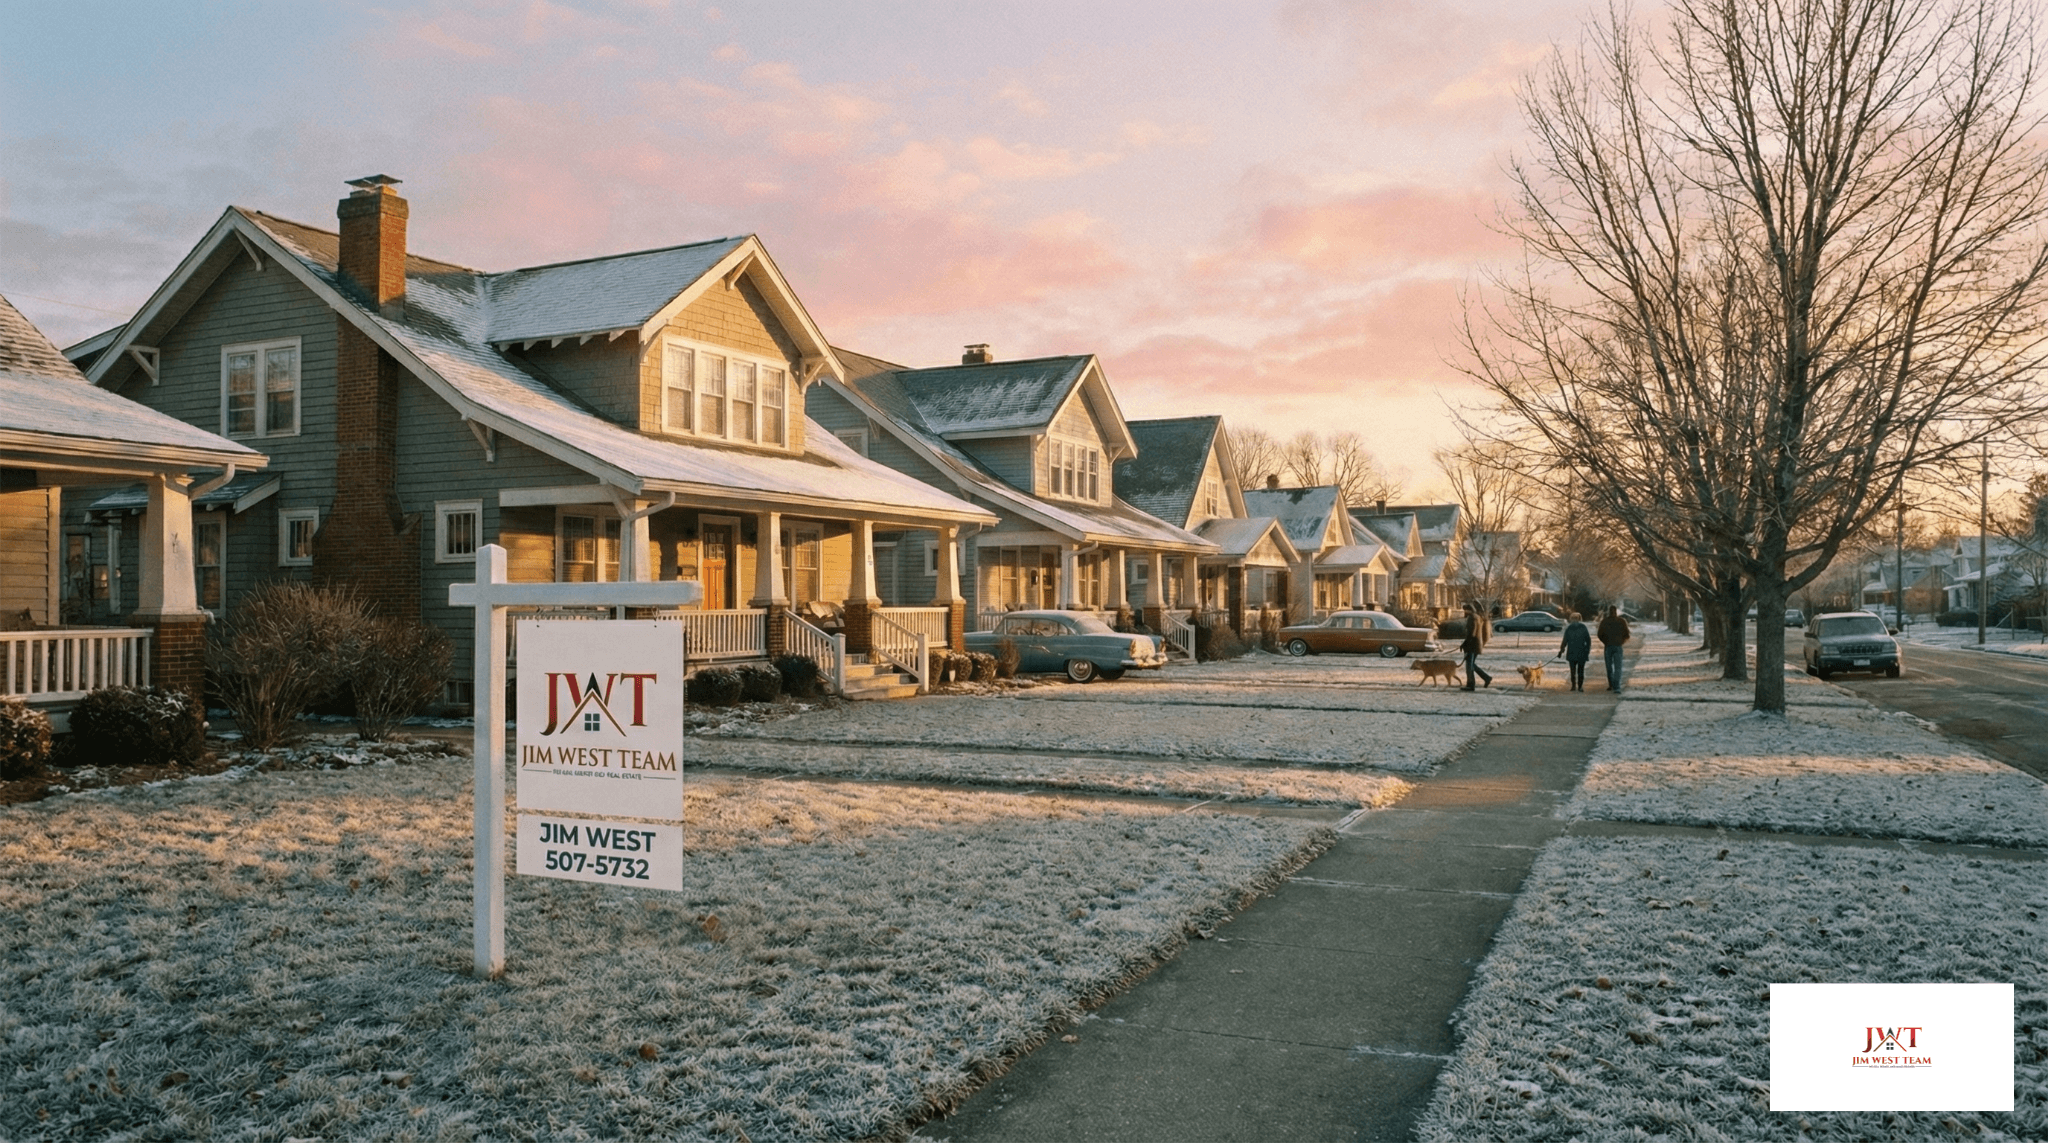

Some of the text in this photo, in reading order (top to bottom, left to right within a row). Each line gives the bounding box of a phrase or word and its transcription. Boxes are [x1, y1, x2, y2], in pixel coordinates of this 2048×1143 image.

[539, 672, 657, 736] JWT
[521, 745, 677, 771] JIM WEST TEAM
[539, 822, 656, 853] JIM WEST
[545, 849, 650, 880] 507-5732
